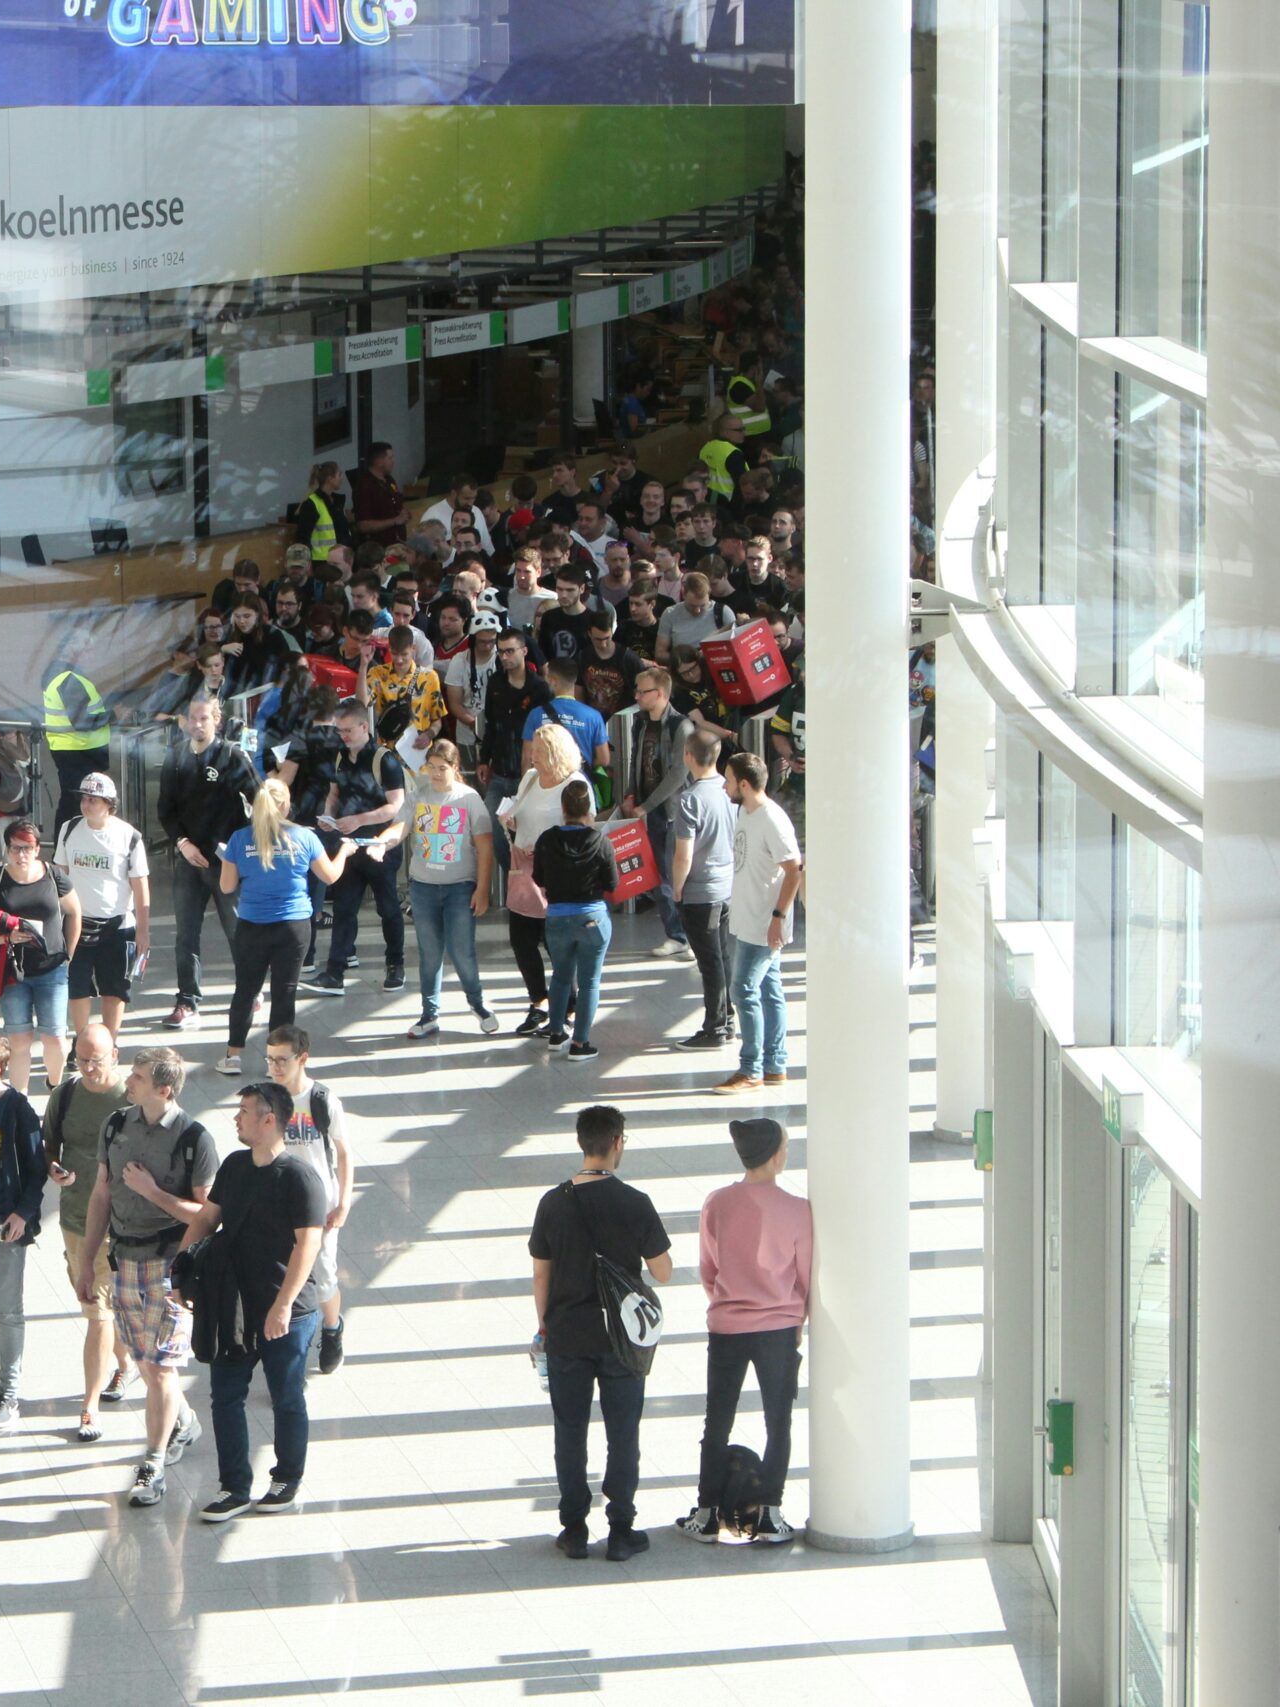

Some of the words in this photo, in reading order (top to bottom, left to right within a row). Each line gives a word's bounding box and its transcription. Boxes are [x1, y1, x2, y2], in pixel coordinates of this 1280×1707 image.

[107, 0, 390, 46] GAMING
[0, 195, 184, 241] koelnmesse
[71, 259, 117, 276] business
[132, 256, 158, 271] since
[162, 251, 185, 267] 1924
[113, 564, 121, 576] 2
[74, 853, 111, 869] MARVEL
